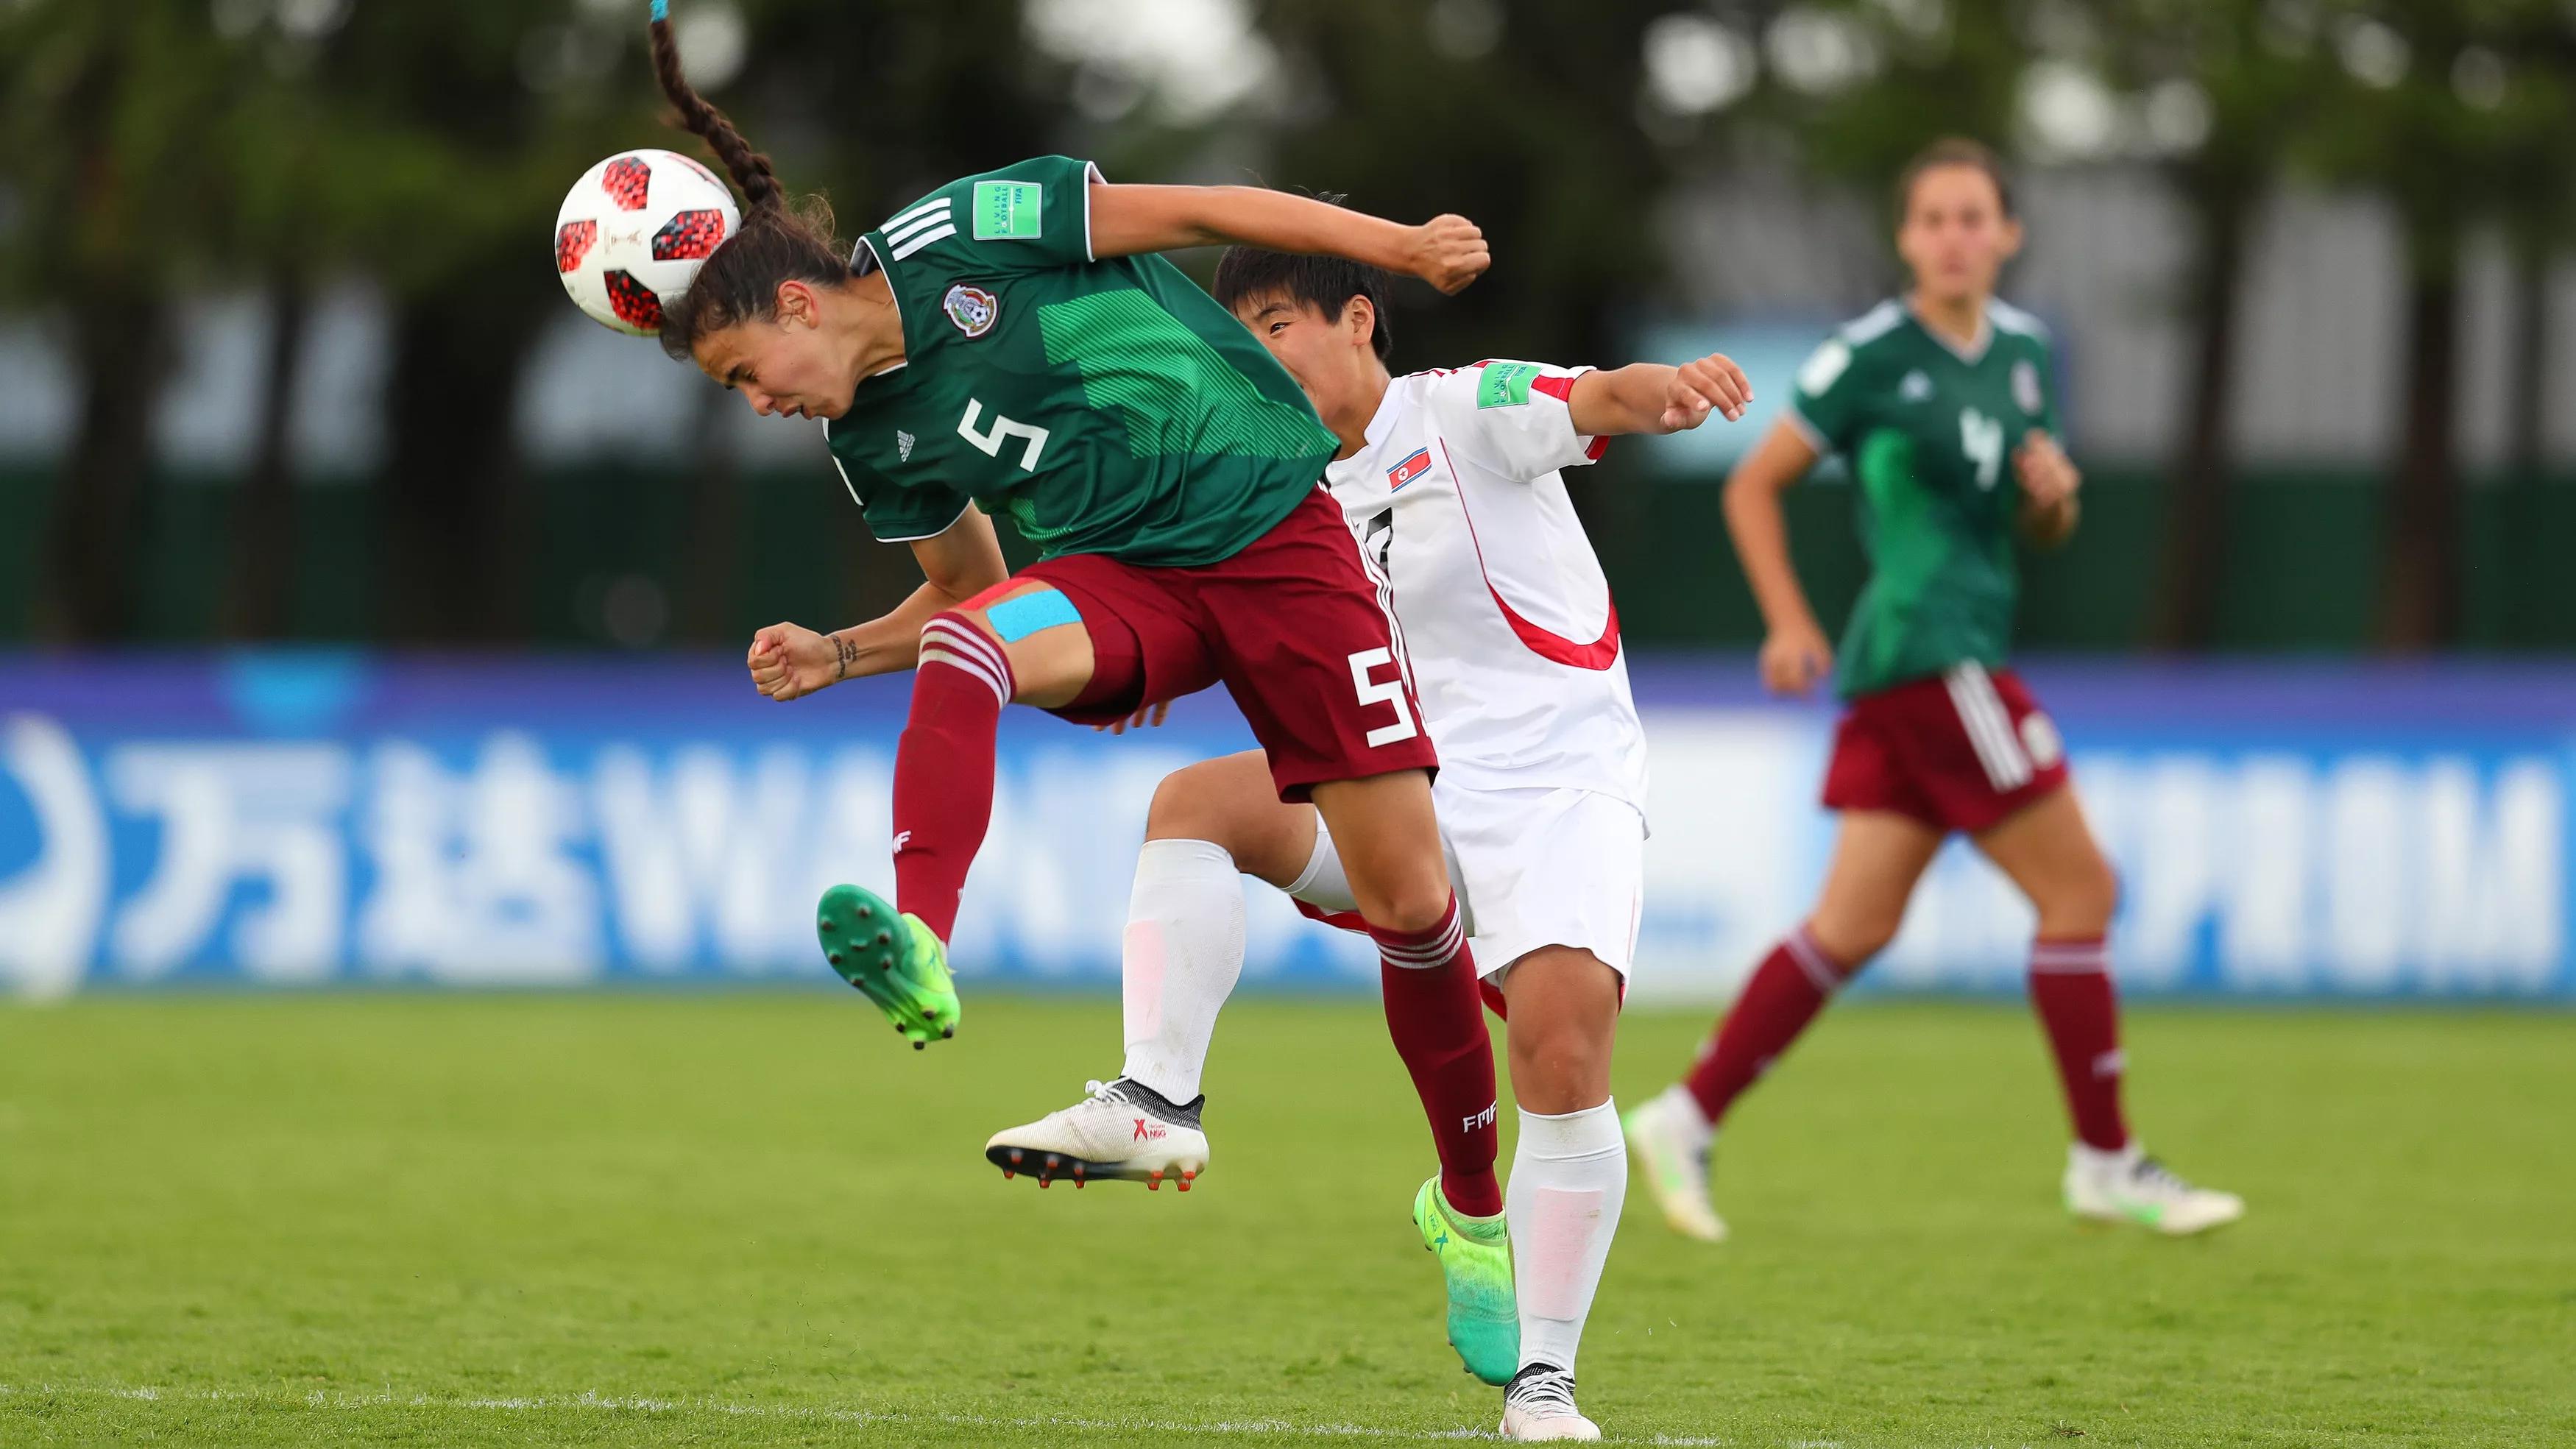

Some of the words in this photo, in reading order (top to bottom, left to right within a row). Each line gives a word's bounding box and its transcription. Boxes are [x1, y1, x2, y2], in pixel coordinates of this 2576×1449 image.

[1015, 187, 1023, 205] FIFA
[957, 397, 1050, 472] 5
[1958, 405, 2004, 492] 4
[1348, 645, 1418, 748] 5
[1462, 1099, 1497, 1133] FMF
